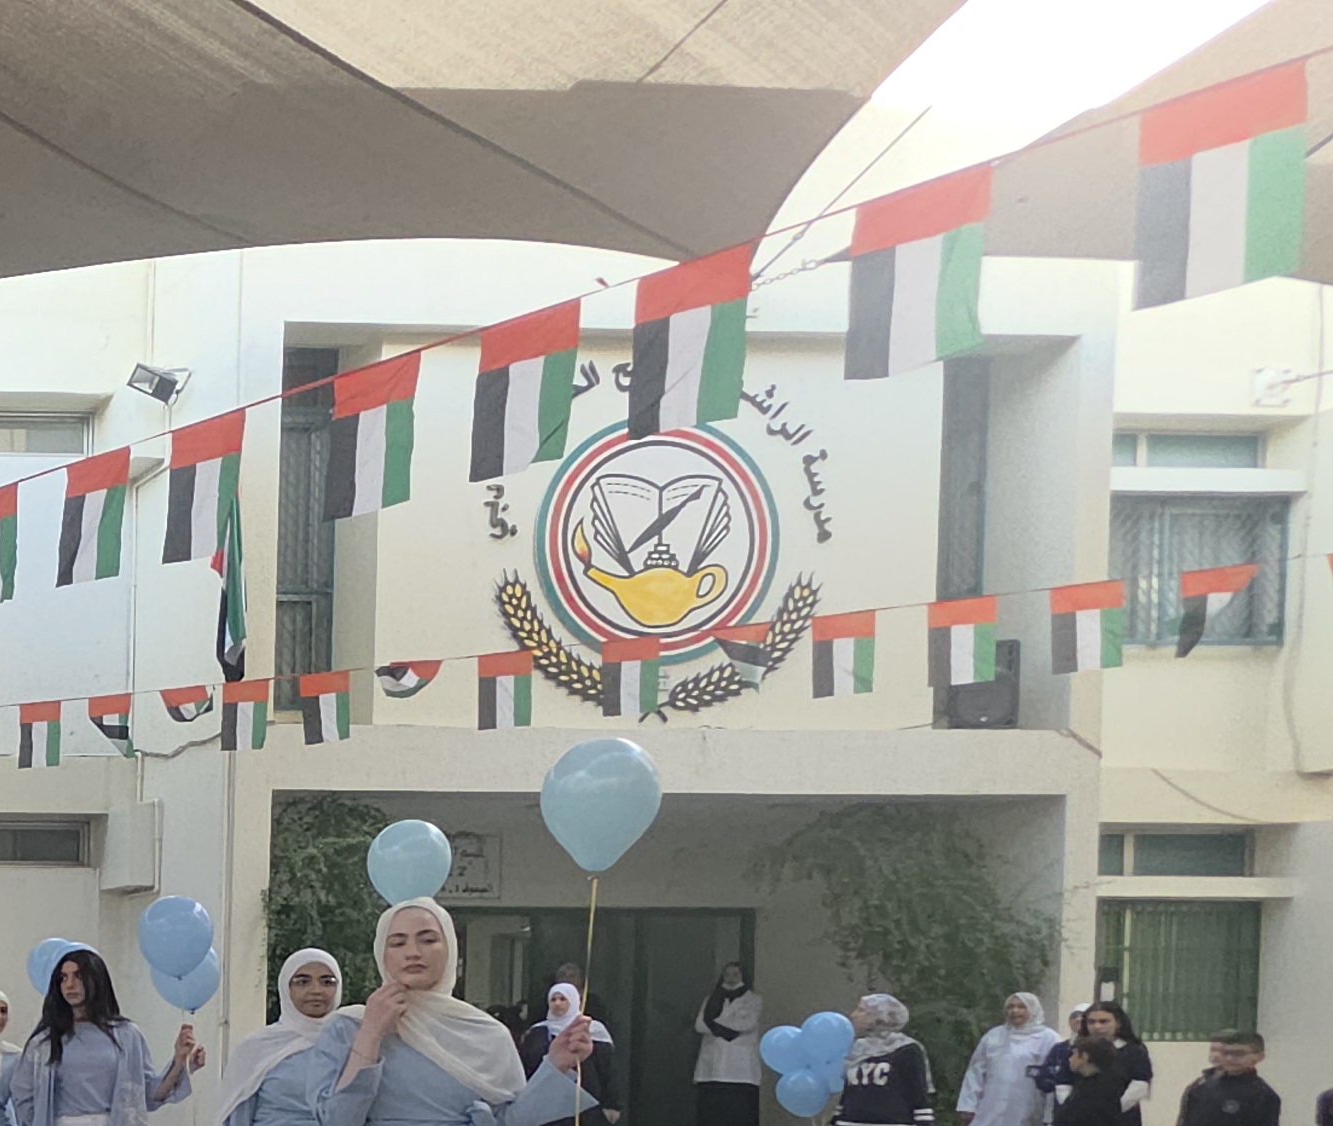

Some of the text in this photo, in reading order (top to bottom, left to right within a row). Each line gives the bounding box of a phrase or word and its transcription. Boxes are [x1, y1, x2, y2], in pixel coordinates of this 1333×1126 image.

[483, 383, 833, 544] مدرسة الراش دبي
